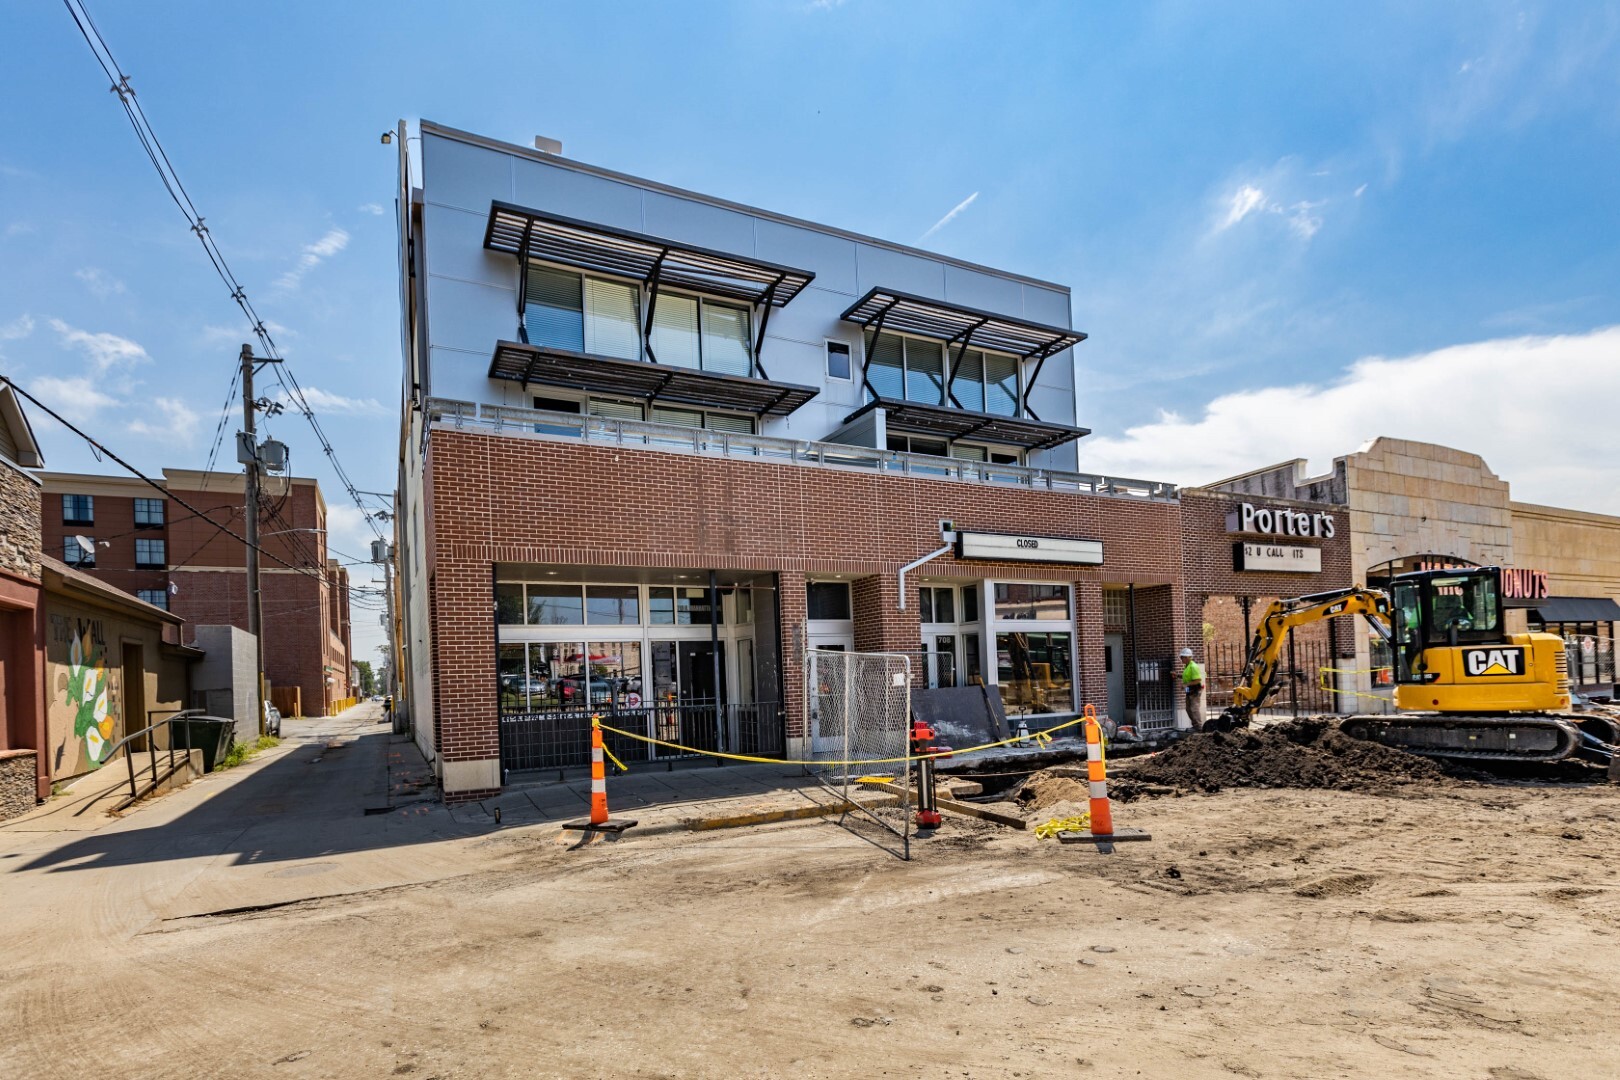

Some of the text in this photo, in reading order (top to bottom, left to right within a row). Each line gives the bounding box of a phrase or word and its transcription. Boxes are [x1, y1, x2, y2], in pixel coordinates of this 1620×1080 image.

[1240, 502, 1335, 538] Porter's
[1016, 538, 1039, 549] CLOSED
[1256, 547, 1261, 556] U
[1266, 547, 1284, 558] CALL
[1292, 549, 1304, 558] ITS
[1468, 649, 1519, 675] CAT
